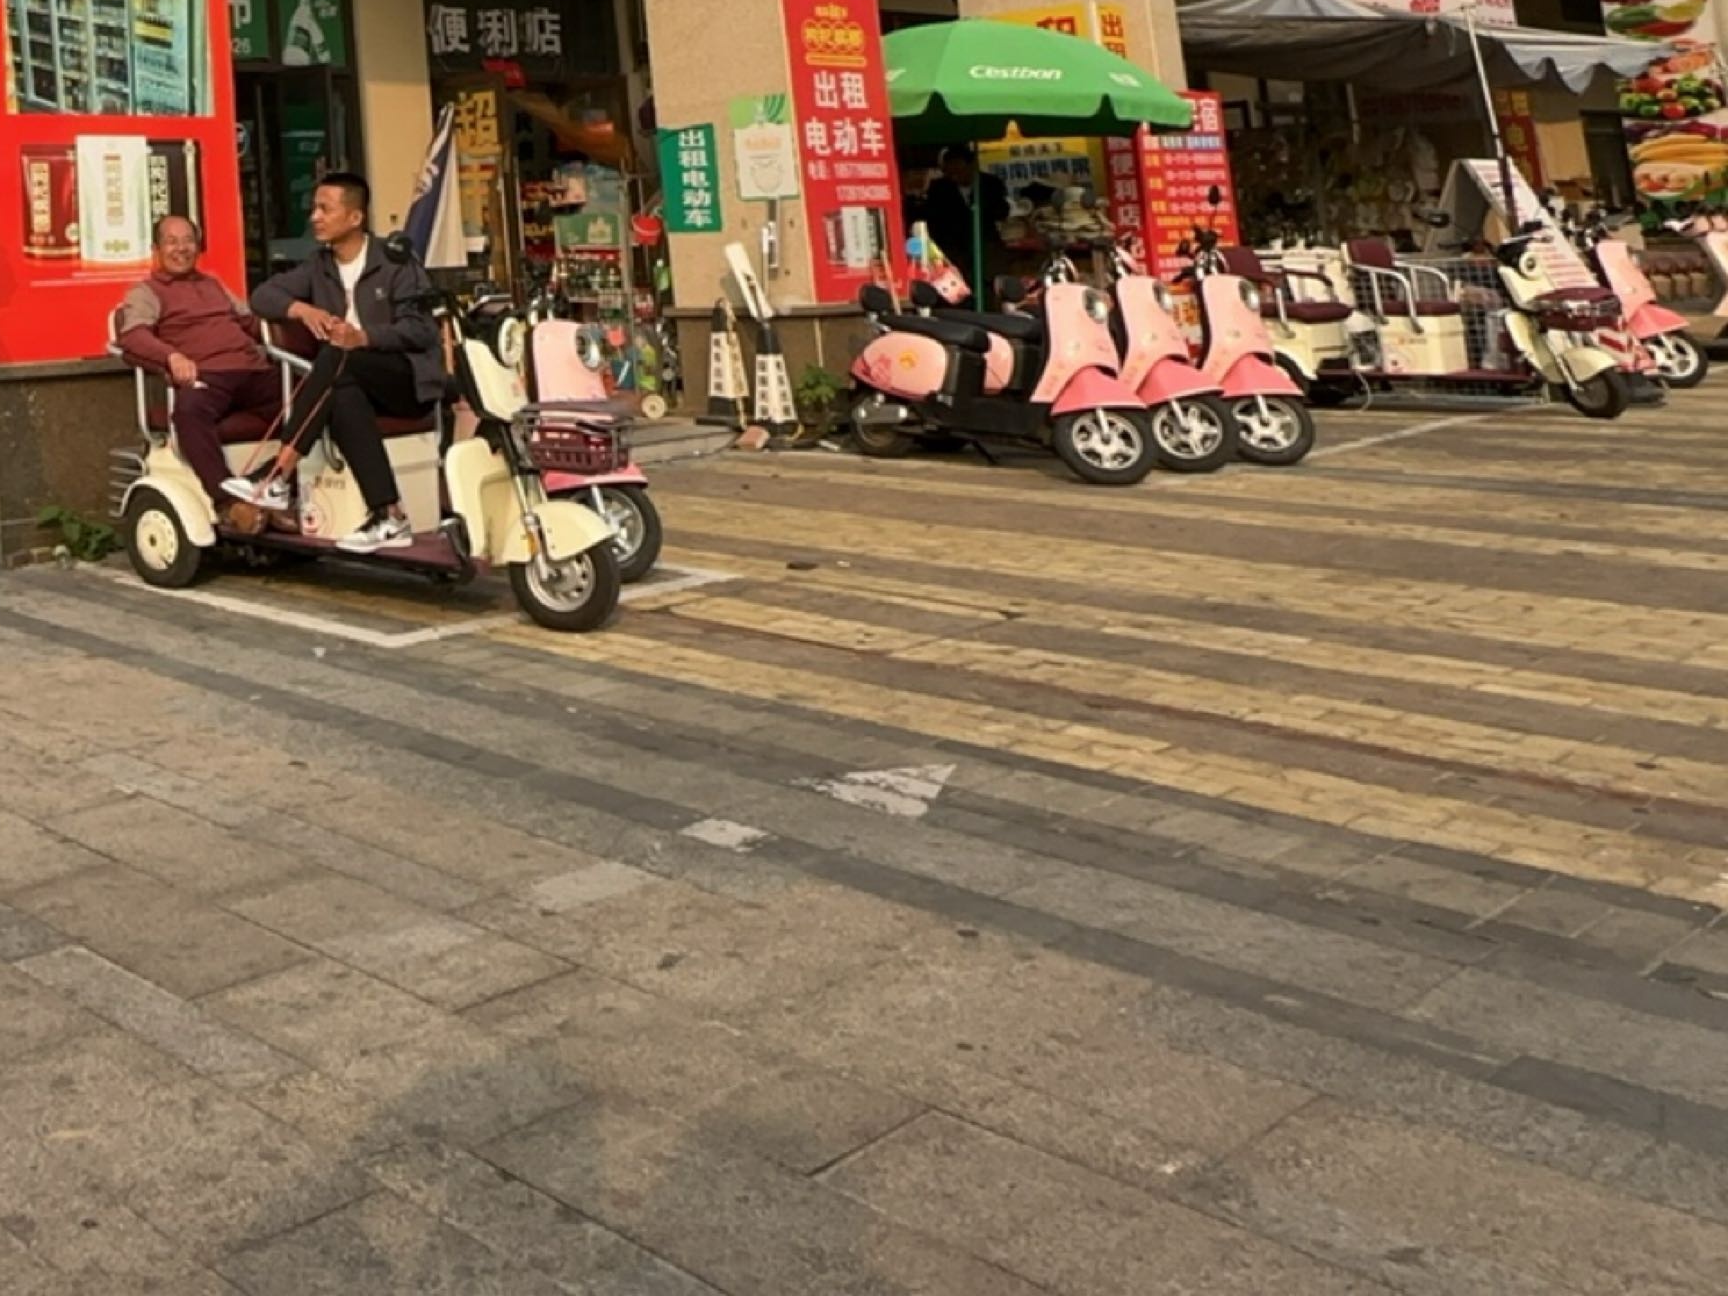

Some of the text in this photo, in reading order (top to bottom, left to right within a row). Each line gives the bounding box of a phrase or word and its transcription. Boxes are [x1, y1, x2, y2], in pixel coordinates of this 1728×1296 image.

[429, 4, 563, 56] 便利店
[813, 69, 871, 110] 出租
[804, 116, 887, 158] 电动车
[677, 128, 713, 227] 出租电动车
